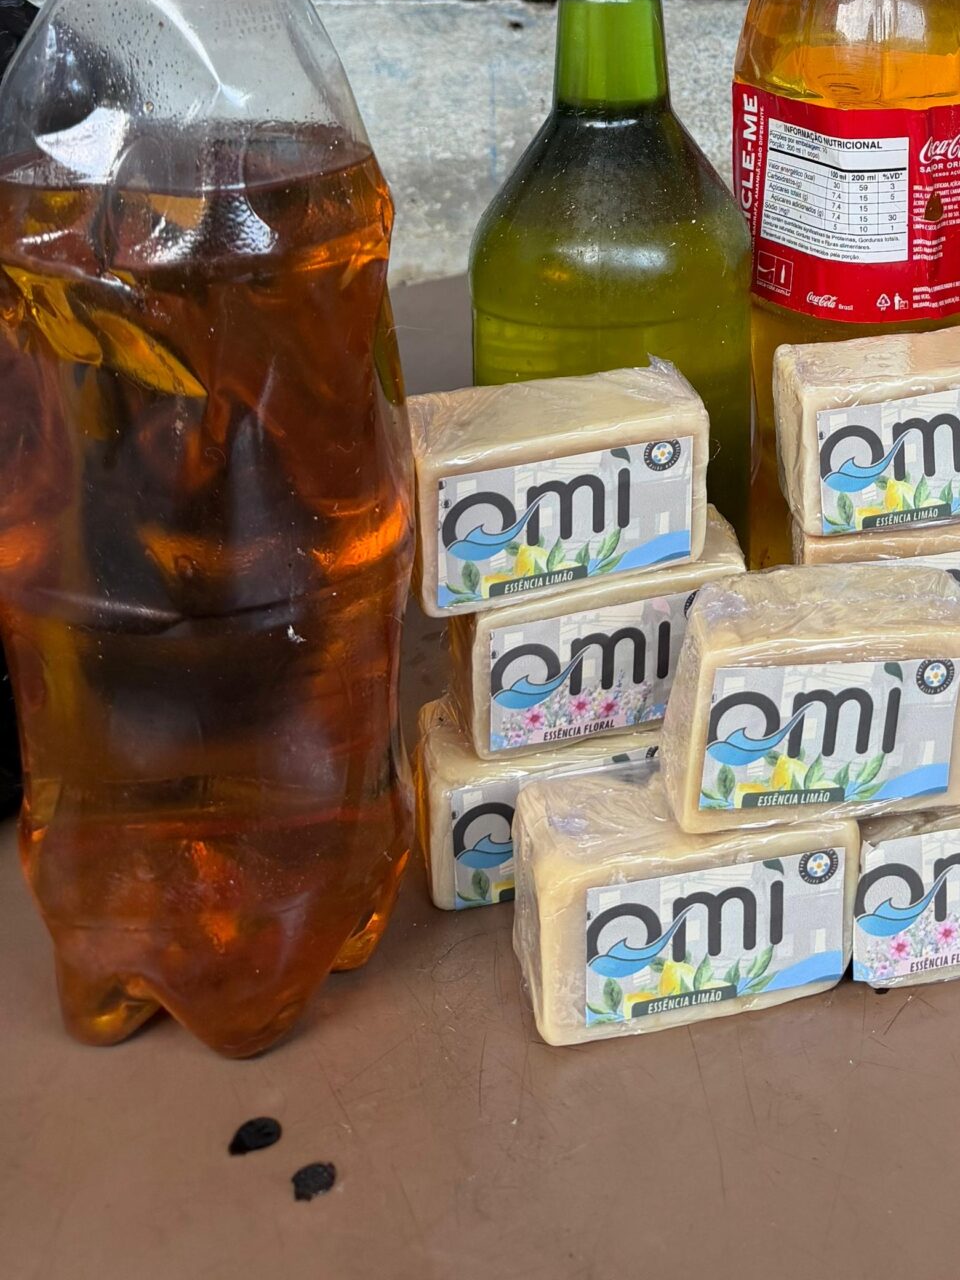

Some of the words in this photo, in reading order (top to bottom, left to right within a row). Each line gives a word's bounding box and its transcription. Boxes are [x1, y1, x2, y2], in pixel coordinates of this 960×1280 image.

[784, 124, 822, 143] INFORMAÇÃO
[824, 138, 882, 150] NUTRICIONAL
[741, 93, 758, 223] ICLE-ME
[920, 163, 944, 173] SAOR
[876, 511, 911, 527] ESSÊNCIA
[913, 507, 939, 519] LIMÃO
[504, 576, 543, 595] ESSÊNCIA
[546, 570, 574, 586] LIMÃO
[543, 725, 582, 741] ESSÊNCIA
[583, 719, 615, 733] FLORAL
[757, 792, 799, 807] ESSÊNCIA
[801, 790, 830, 804] LIMÃO
[910, 956, 949, 972] ESSÊNCIA
[648, 997, 689, 1014] ESSÊNCIA
[692, 990, 722, 1006] LIMÃO
